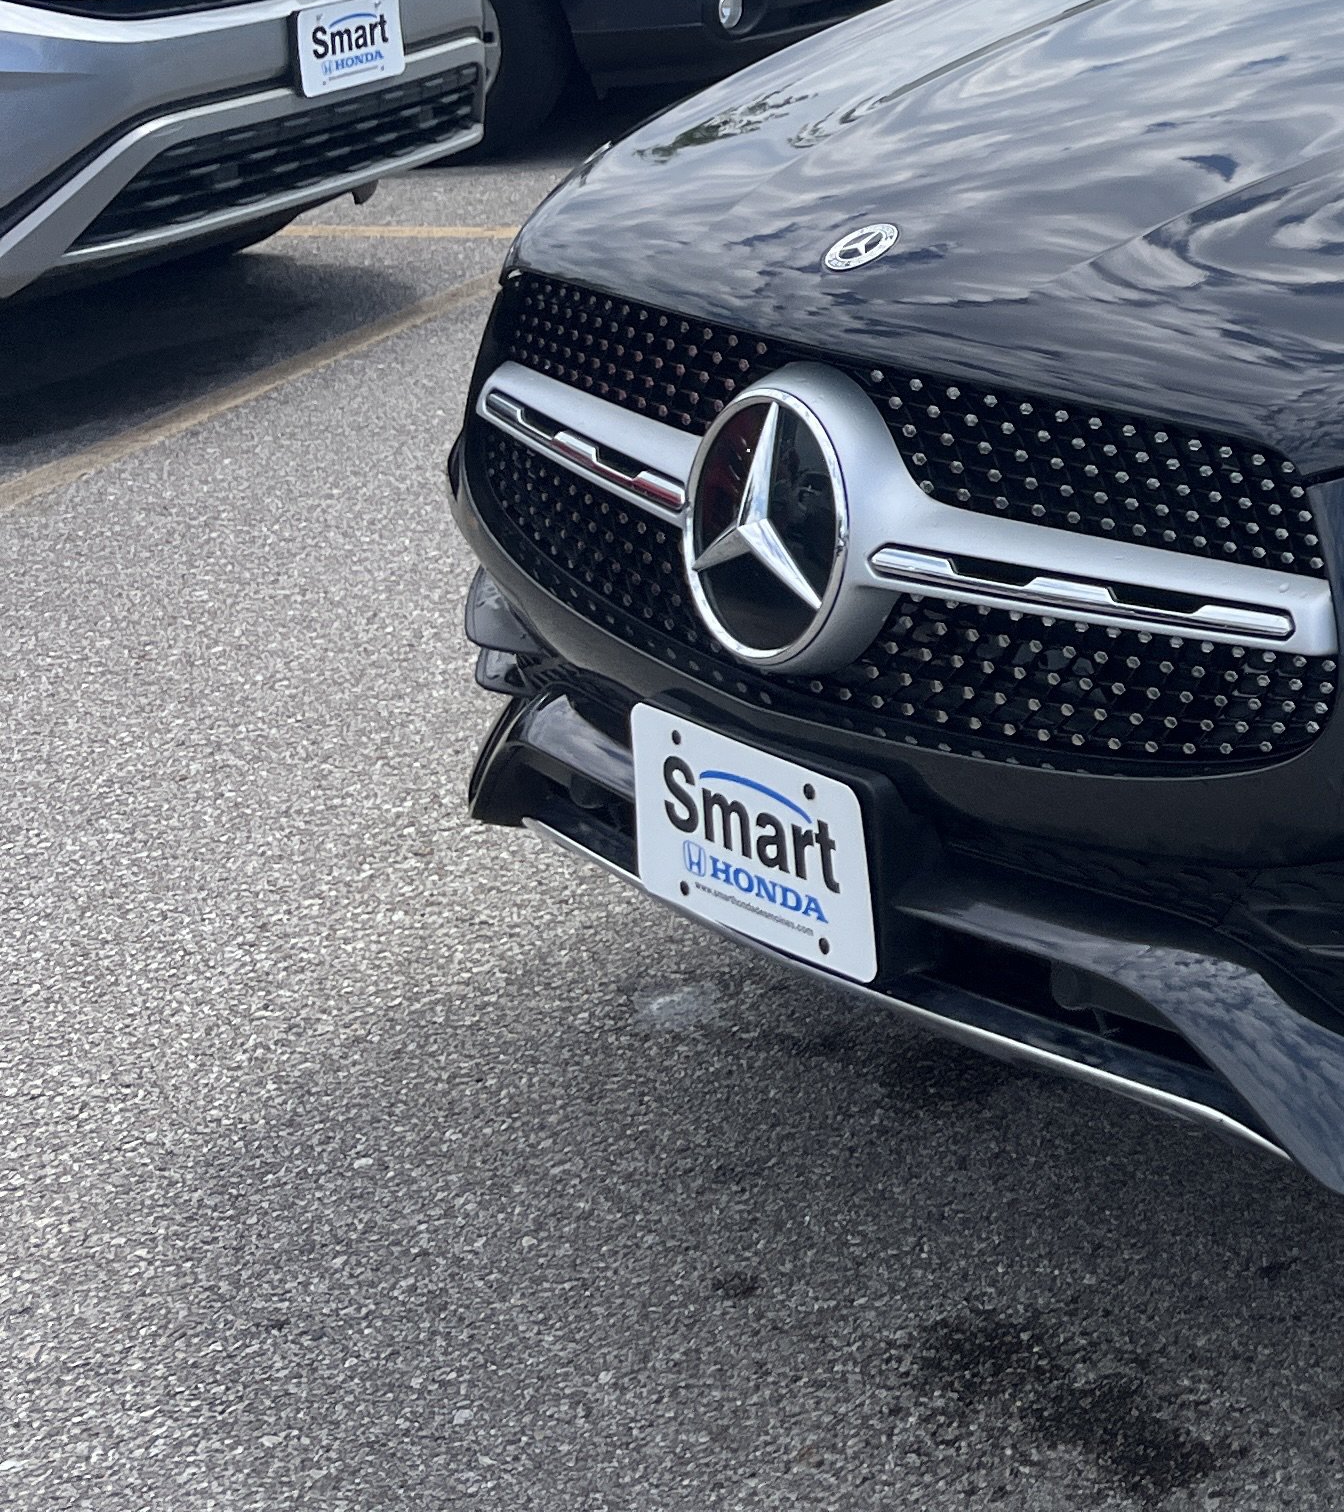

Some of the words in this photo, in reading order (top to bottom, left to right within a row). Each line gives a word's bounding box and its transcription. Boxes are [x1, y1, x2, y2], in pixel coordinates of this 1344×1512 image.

[311, 14, 389, 59] Smart
[335, 49, 385, 71] HONDA
[662, 755, 841, 894] Smart
[710, 855, 829, 924] HONDA
